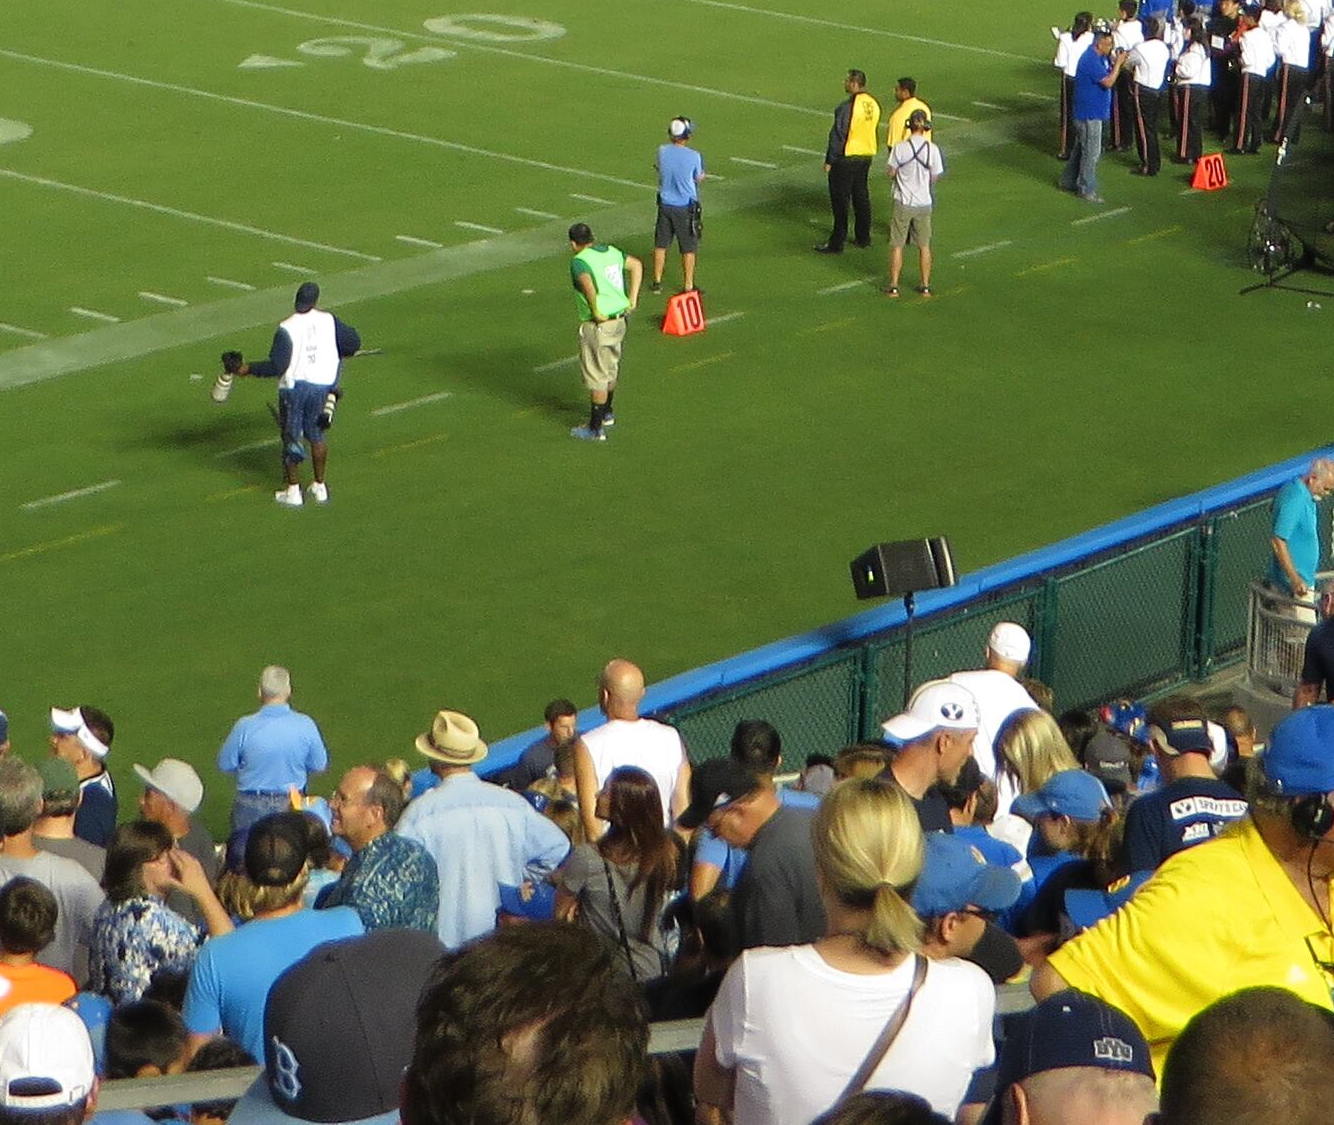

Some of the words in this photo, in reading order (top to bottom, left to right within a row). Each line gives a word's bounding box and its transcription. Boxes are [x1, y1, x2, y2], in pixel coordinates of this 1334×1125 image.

[294, 11, 569, 70] 20
[1204, 156, 1224, 188] 20
[677, 295, 702, 332] 10
[272, 1034, 301, 1099] B
